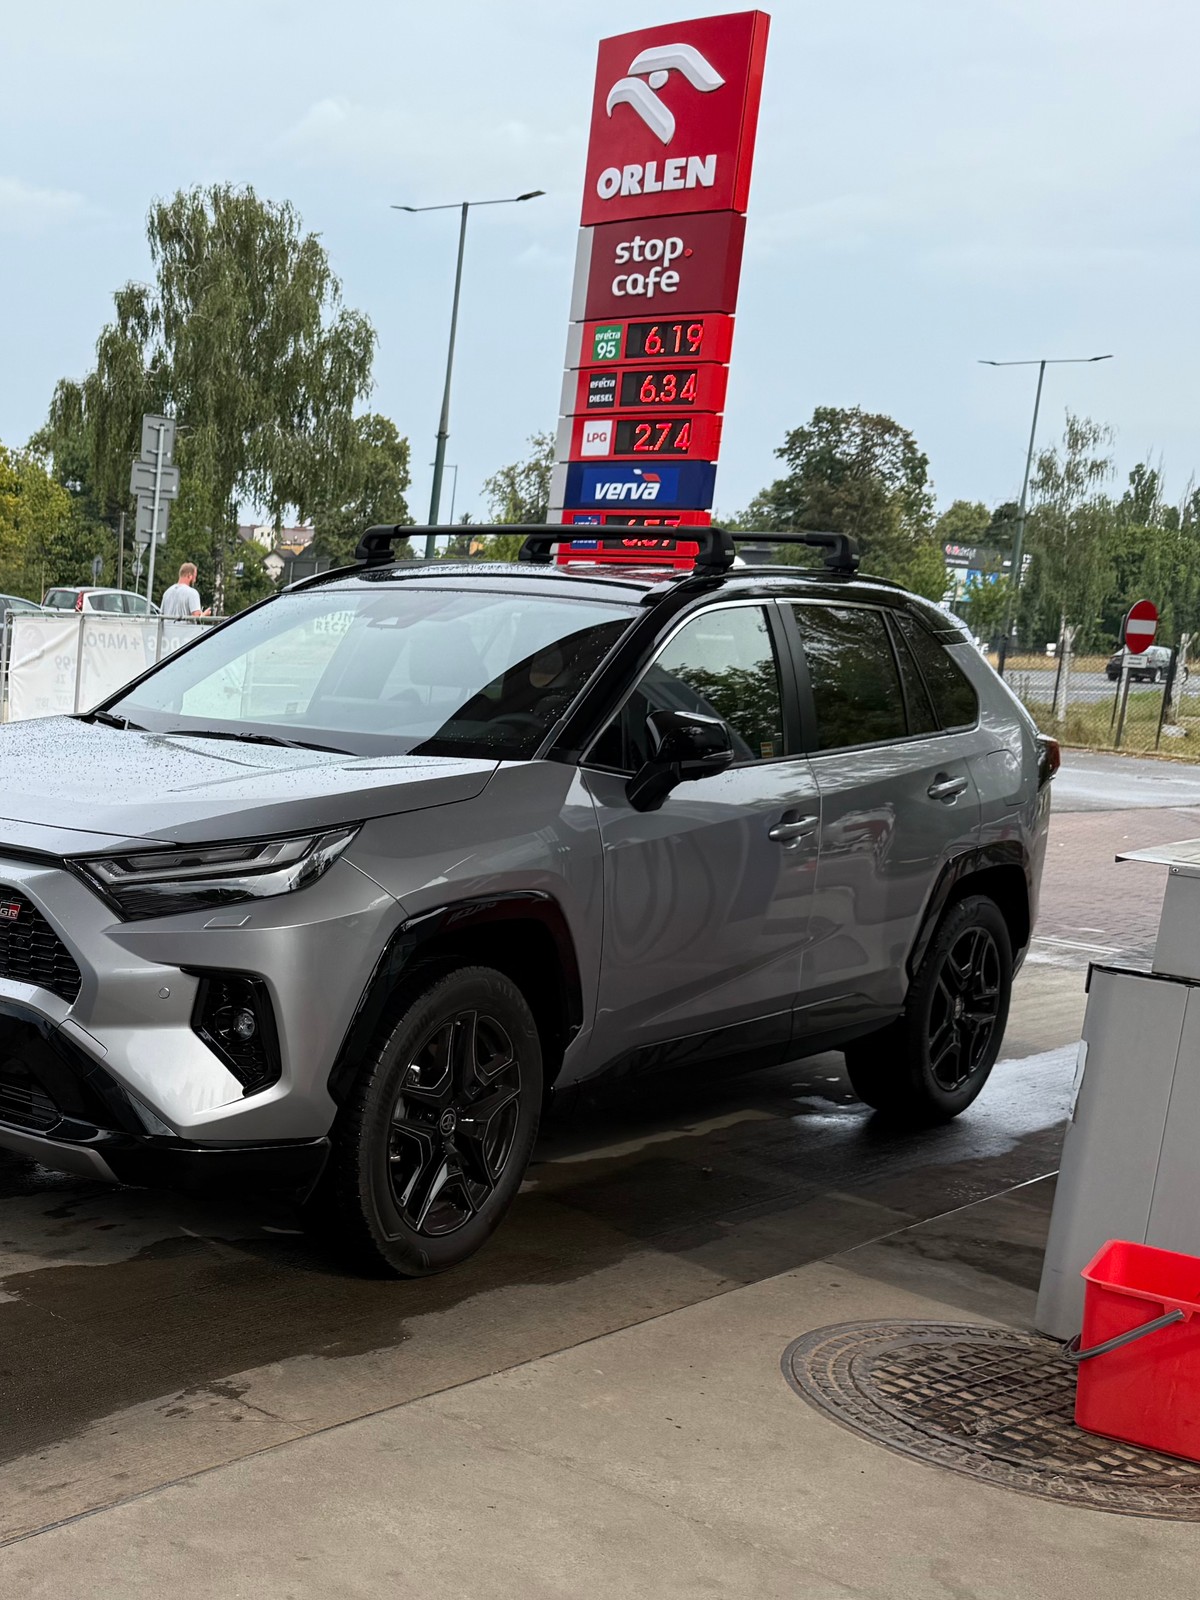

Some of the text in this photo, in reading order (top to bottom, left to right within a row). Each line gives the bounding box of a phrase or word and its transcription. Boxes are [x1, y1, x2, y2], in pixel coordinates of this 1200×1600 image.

[596, 154, 717, 200] ORLEN
[611, 266, 680, 297] cafe
[597, 341, 616, 359] 95
[644, 323, 704, 355] 6.19
[589, 393, 614, 403] DIESEL
[639, 373, 697, 403] 6.34
[586, 432, 607, 443] LPG
[594, 482, 661, 501] verva
